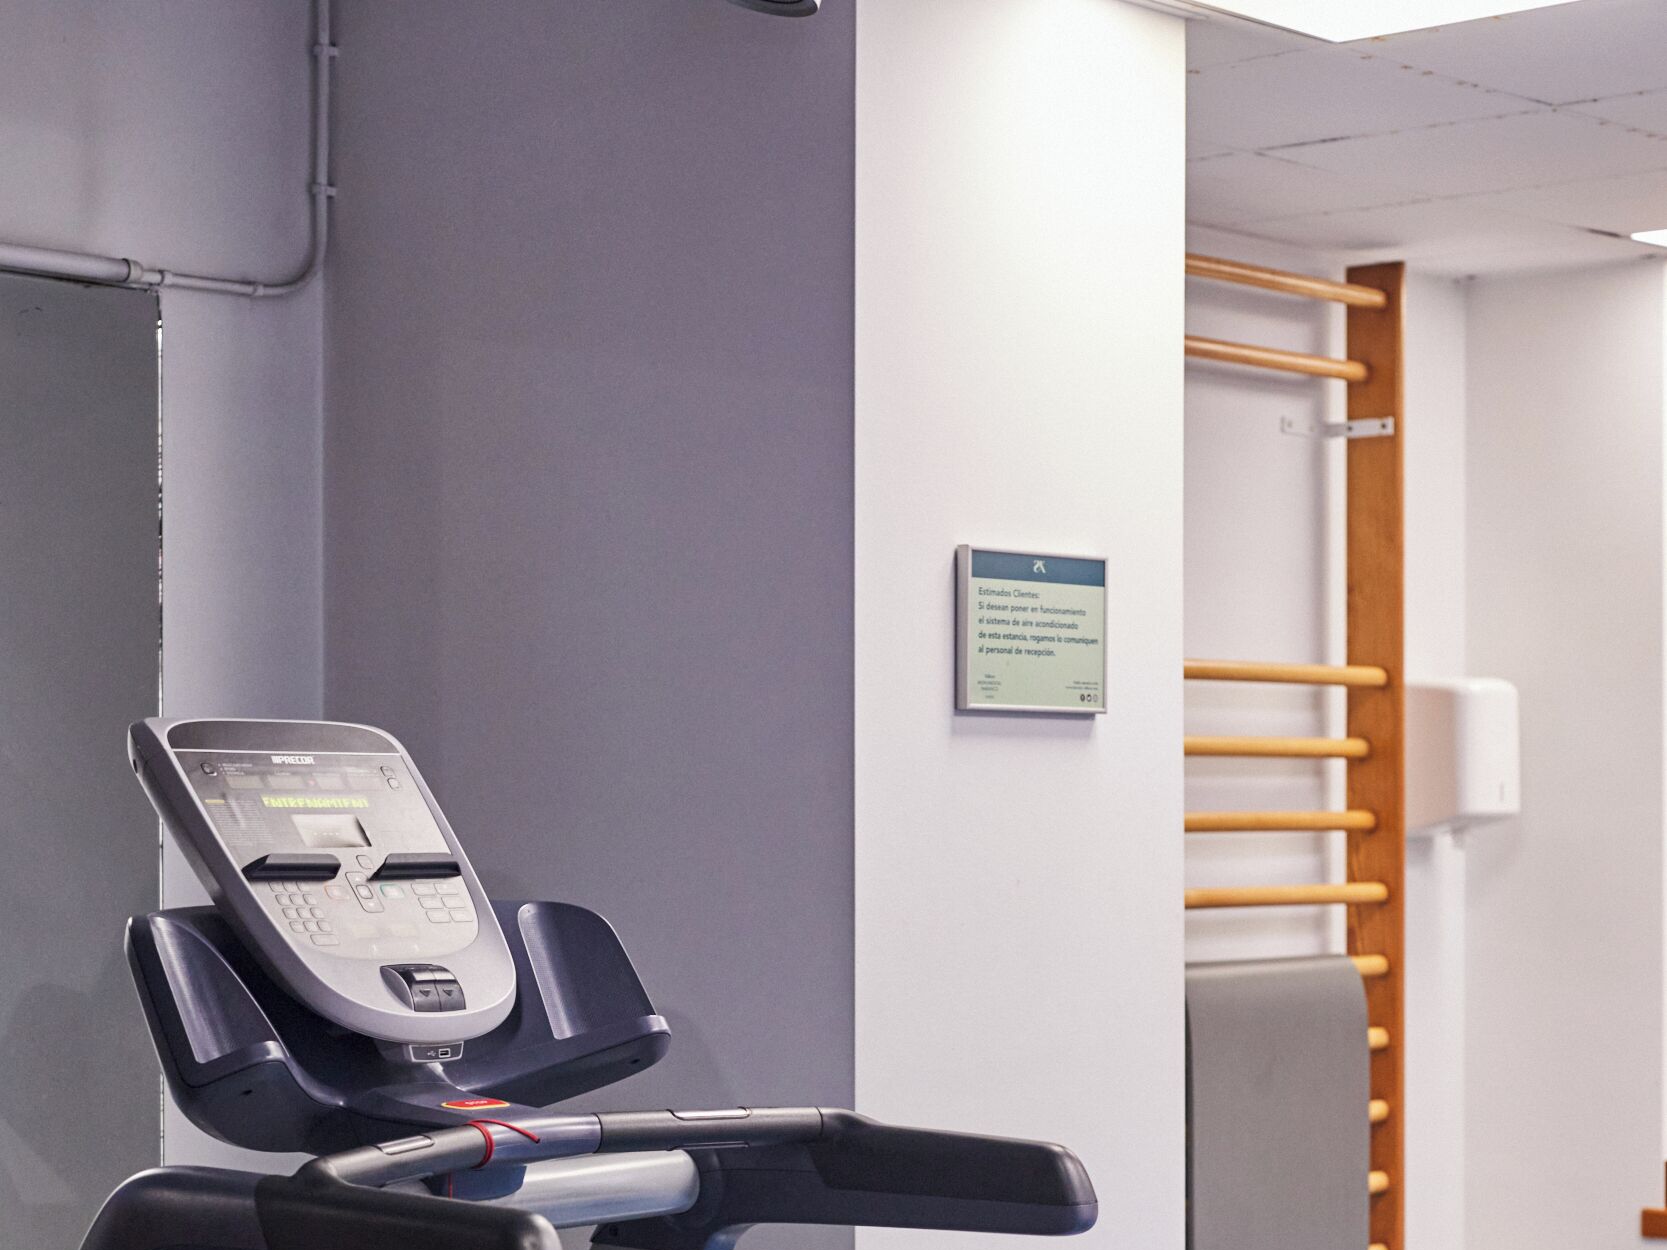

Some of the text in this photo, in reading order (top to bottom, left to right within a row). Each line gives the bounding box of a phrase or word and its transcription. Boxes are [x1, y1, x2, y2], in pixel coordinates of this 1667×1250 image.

[978, 586, 1040, 600] Estimados Clientes:
[978, 601, 985, 610] Si
[986, 602, 1009, 611] desean
[1010, 605, 1029, 613] poner
[1040, 604, 1086, 616] funcionamiento
[978, 616, 1079, 630] el sistema de aire acondicionado
[978, 630, 986, 639] de
[988, 632, 1001, 640] esta
[1002, 631, 1028, 642] estancia,
[1029, 635, 1056, 645] rogamos
[1064, 635, 1098, 647] comuniquen
[978, 644, 1056, 658] al personal de recepción.
[275, 755, 315, 765] PRECOR
